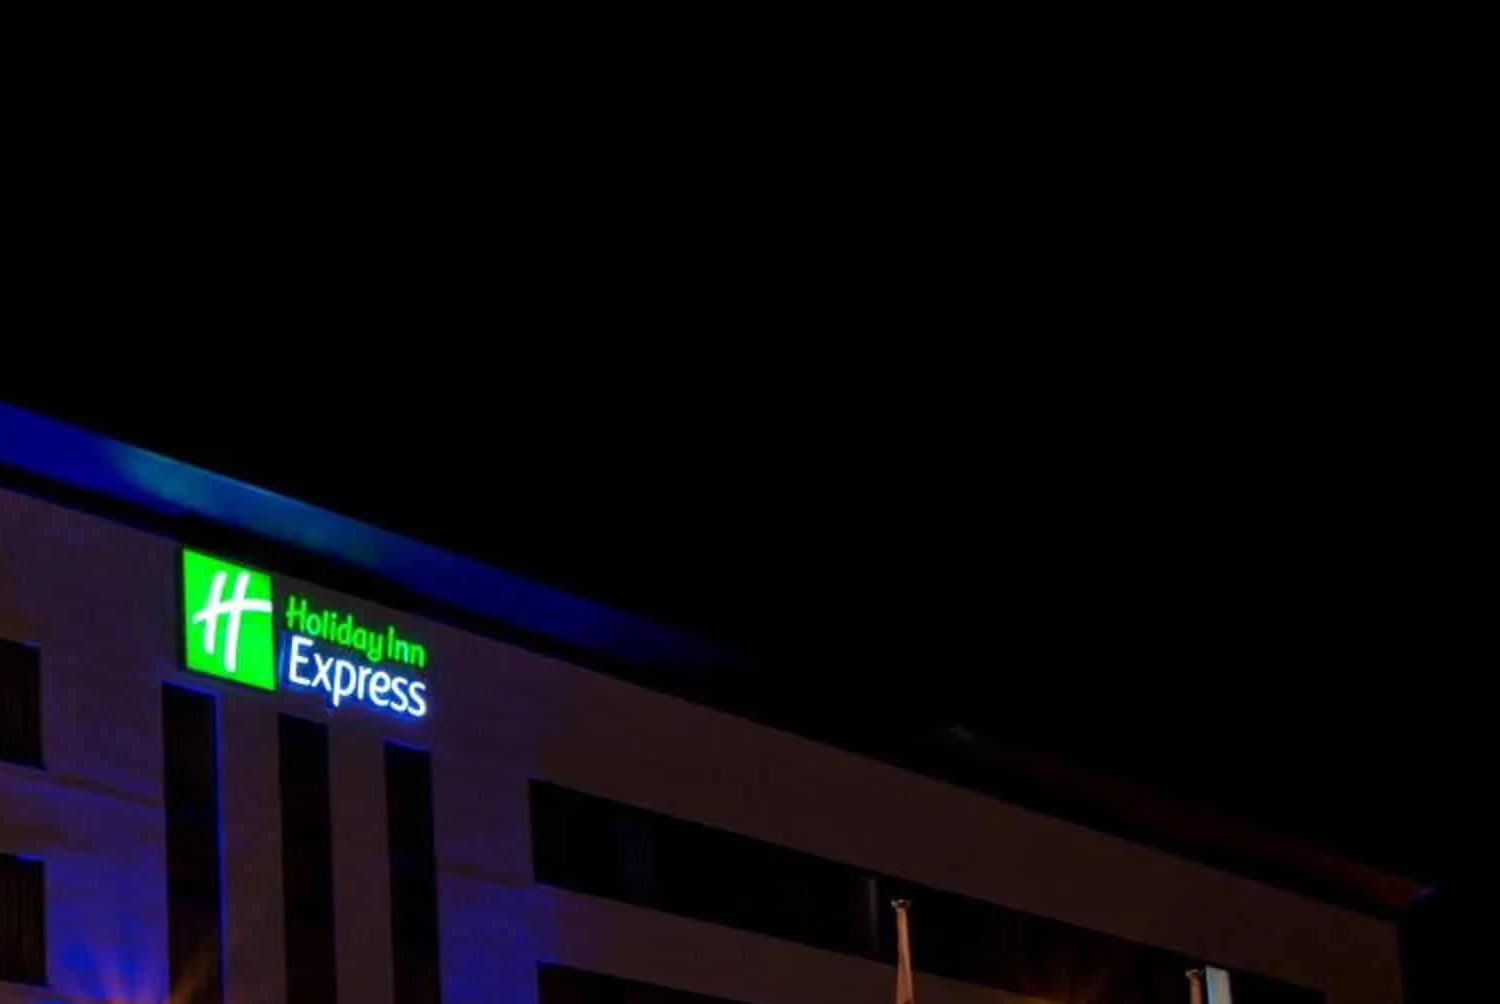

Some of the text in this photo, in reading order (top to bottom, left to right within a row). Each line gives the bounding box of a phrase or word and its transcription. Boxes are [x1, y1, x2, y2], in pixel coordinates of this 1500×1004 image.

[286, 595, 426, 668] Holiday Inn
[289, 634, 428, 717] Express
